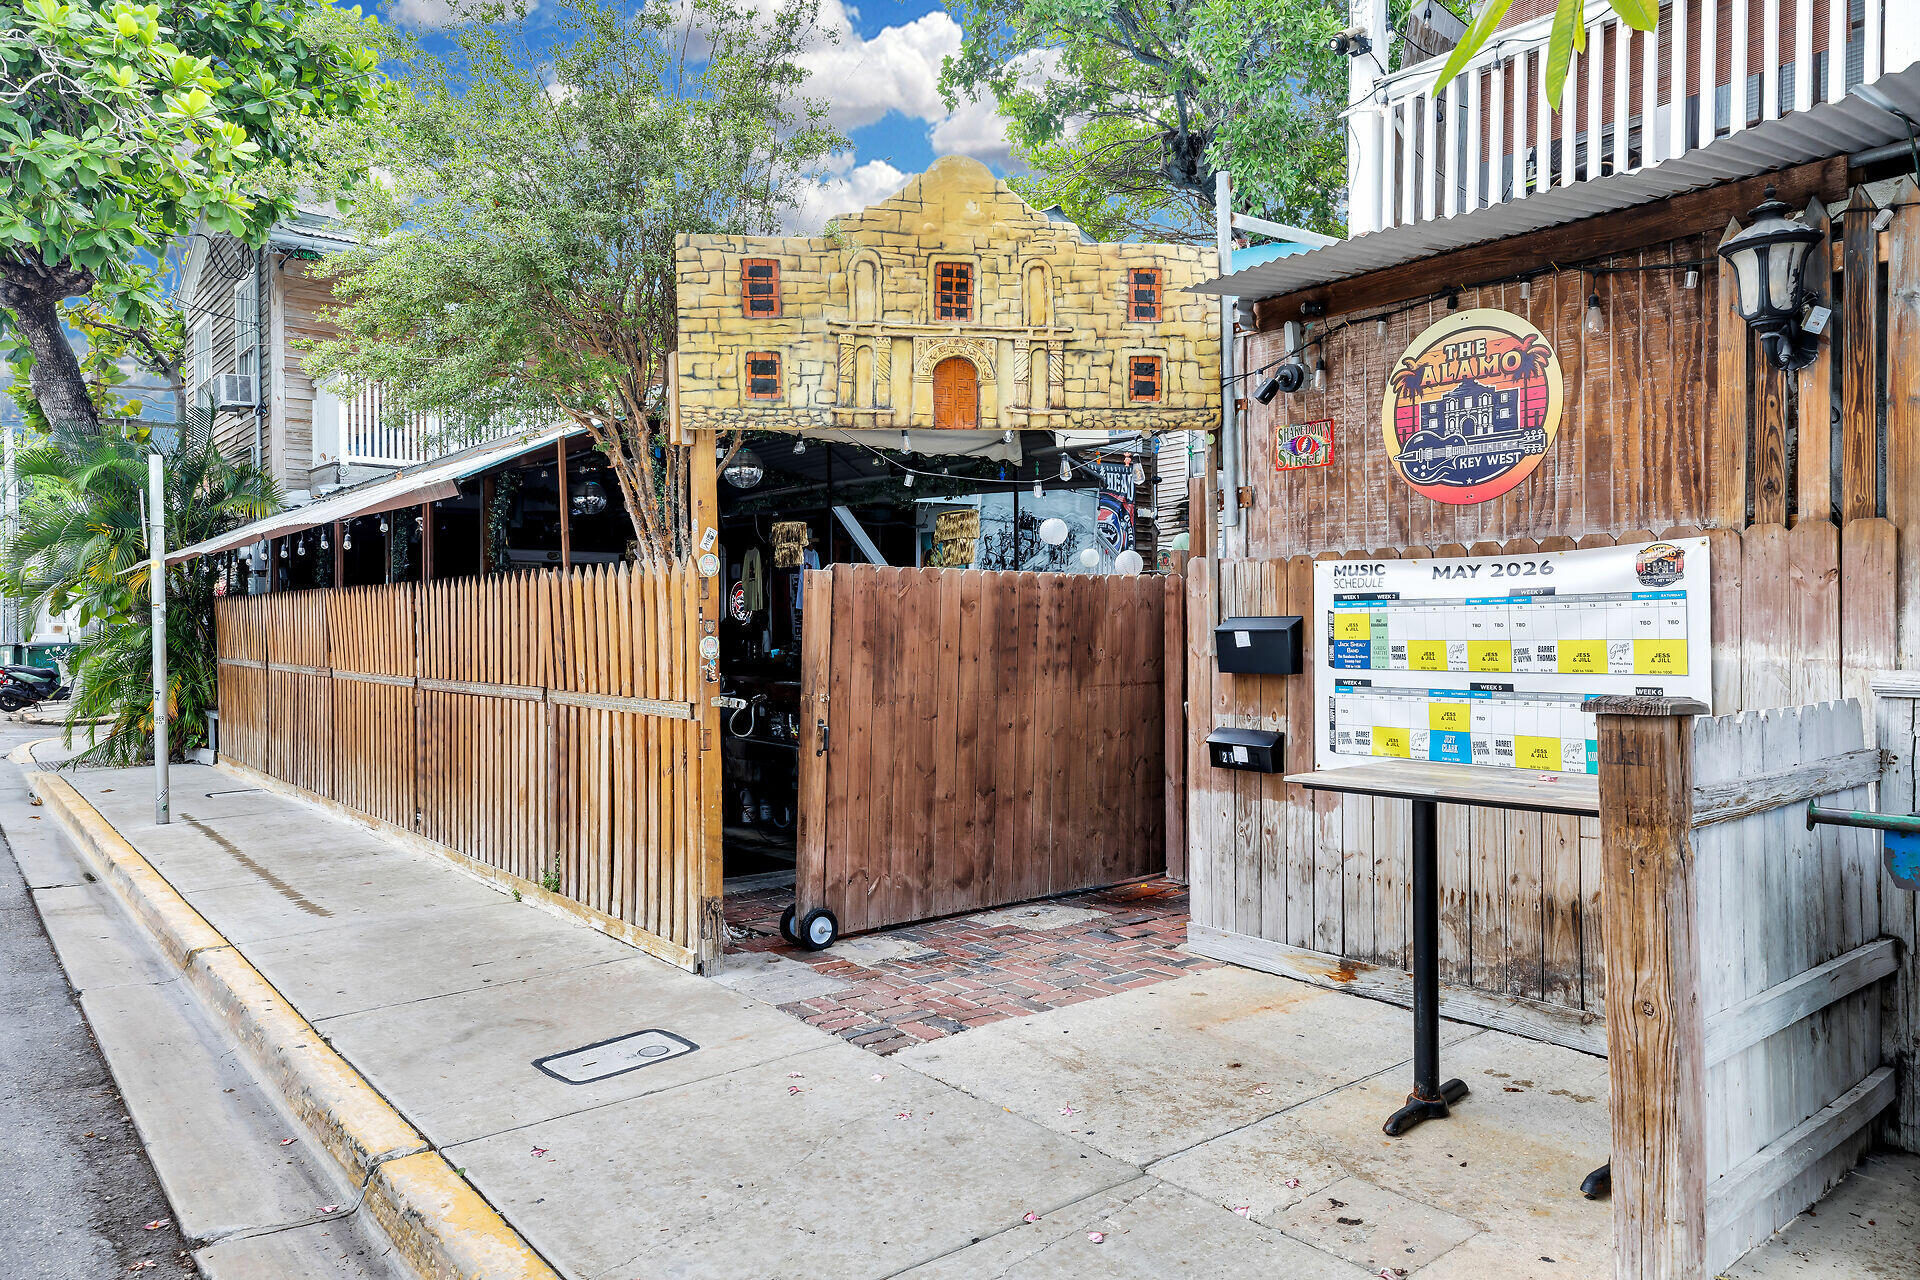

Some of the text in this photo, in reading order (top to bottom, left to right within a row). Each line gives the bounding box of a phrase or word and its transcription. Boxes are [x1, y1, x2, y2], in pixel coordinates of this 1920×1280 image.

[1445, 339, 1486, 360] THE
[1420, 350, 1522, 386] ALAMO
[1278, 421, 1331, 446] SHAKEDOWN
[1278, 443, 1331, 468] STREET
[1460, 452, 1522, 469] KEY WEST
[1333, 563, 1386, 577] MUSIC
[1432, 560, 1554, 580] MAY 2026
[1333, 577, 1384, 589] SCHEDULE
[1514, 648, 1529, 656] JEROME
[1537, 654, 1556, 662] THOMAS
[1442, 744, 1458, 753] CLARK
[1495, 748, 1513, 756] THOMAS
